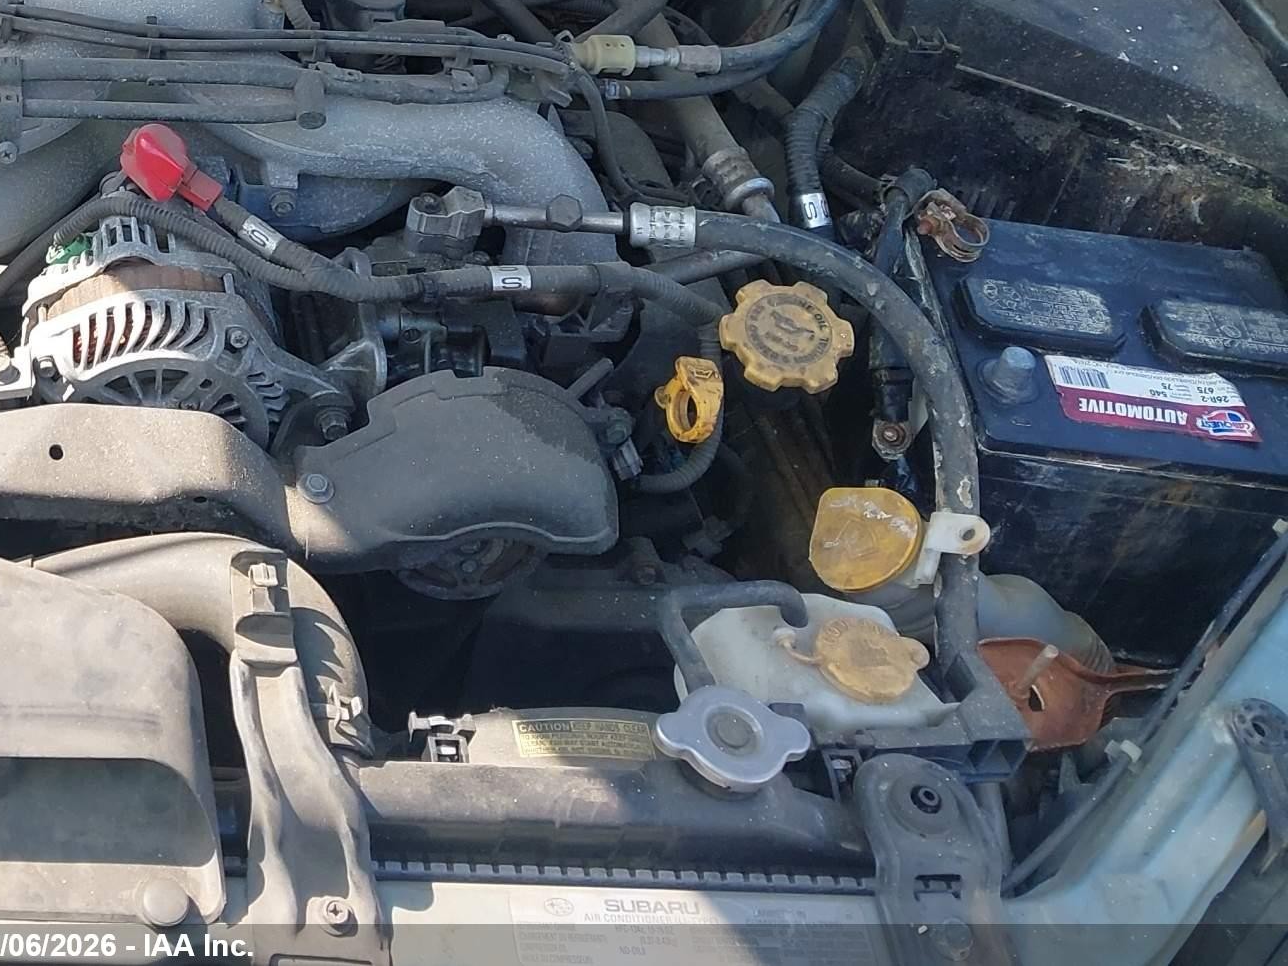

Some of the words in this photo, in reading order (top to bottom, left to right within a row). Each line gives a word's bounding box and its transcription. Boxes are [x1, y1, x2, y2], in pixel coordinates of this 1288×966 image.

[1197, 387, 1214, 395] 675
[1078, 397, 1188, 425] AUTOMOTIVE
[518, 722, 570, 733] CAUTION
[604, 898, 700, 915] SUBARU
[584, 913, 601, 923] AIR
